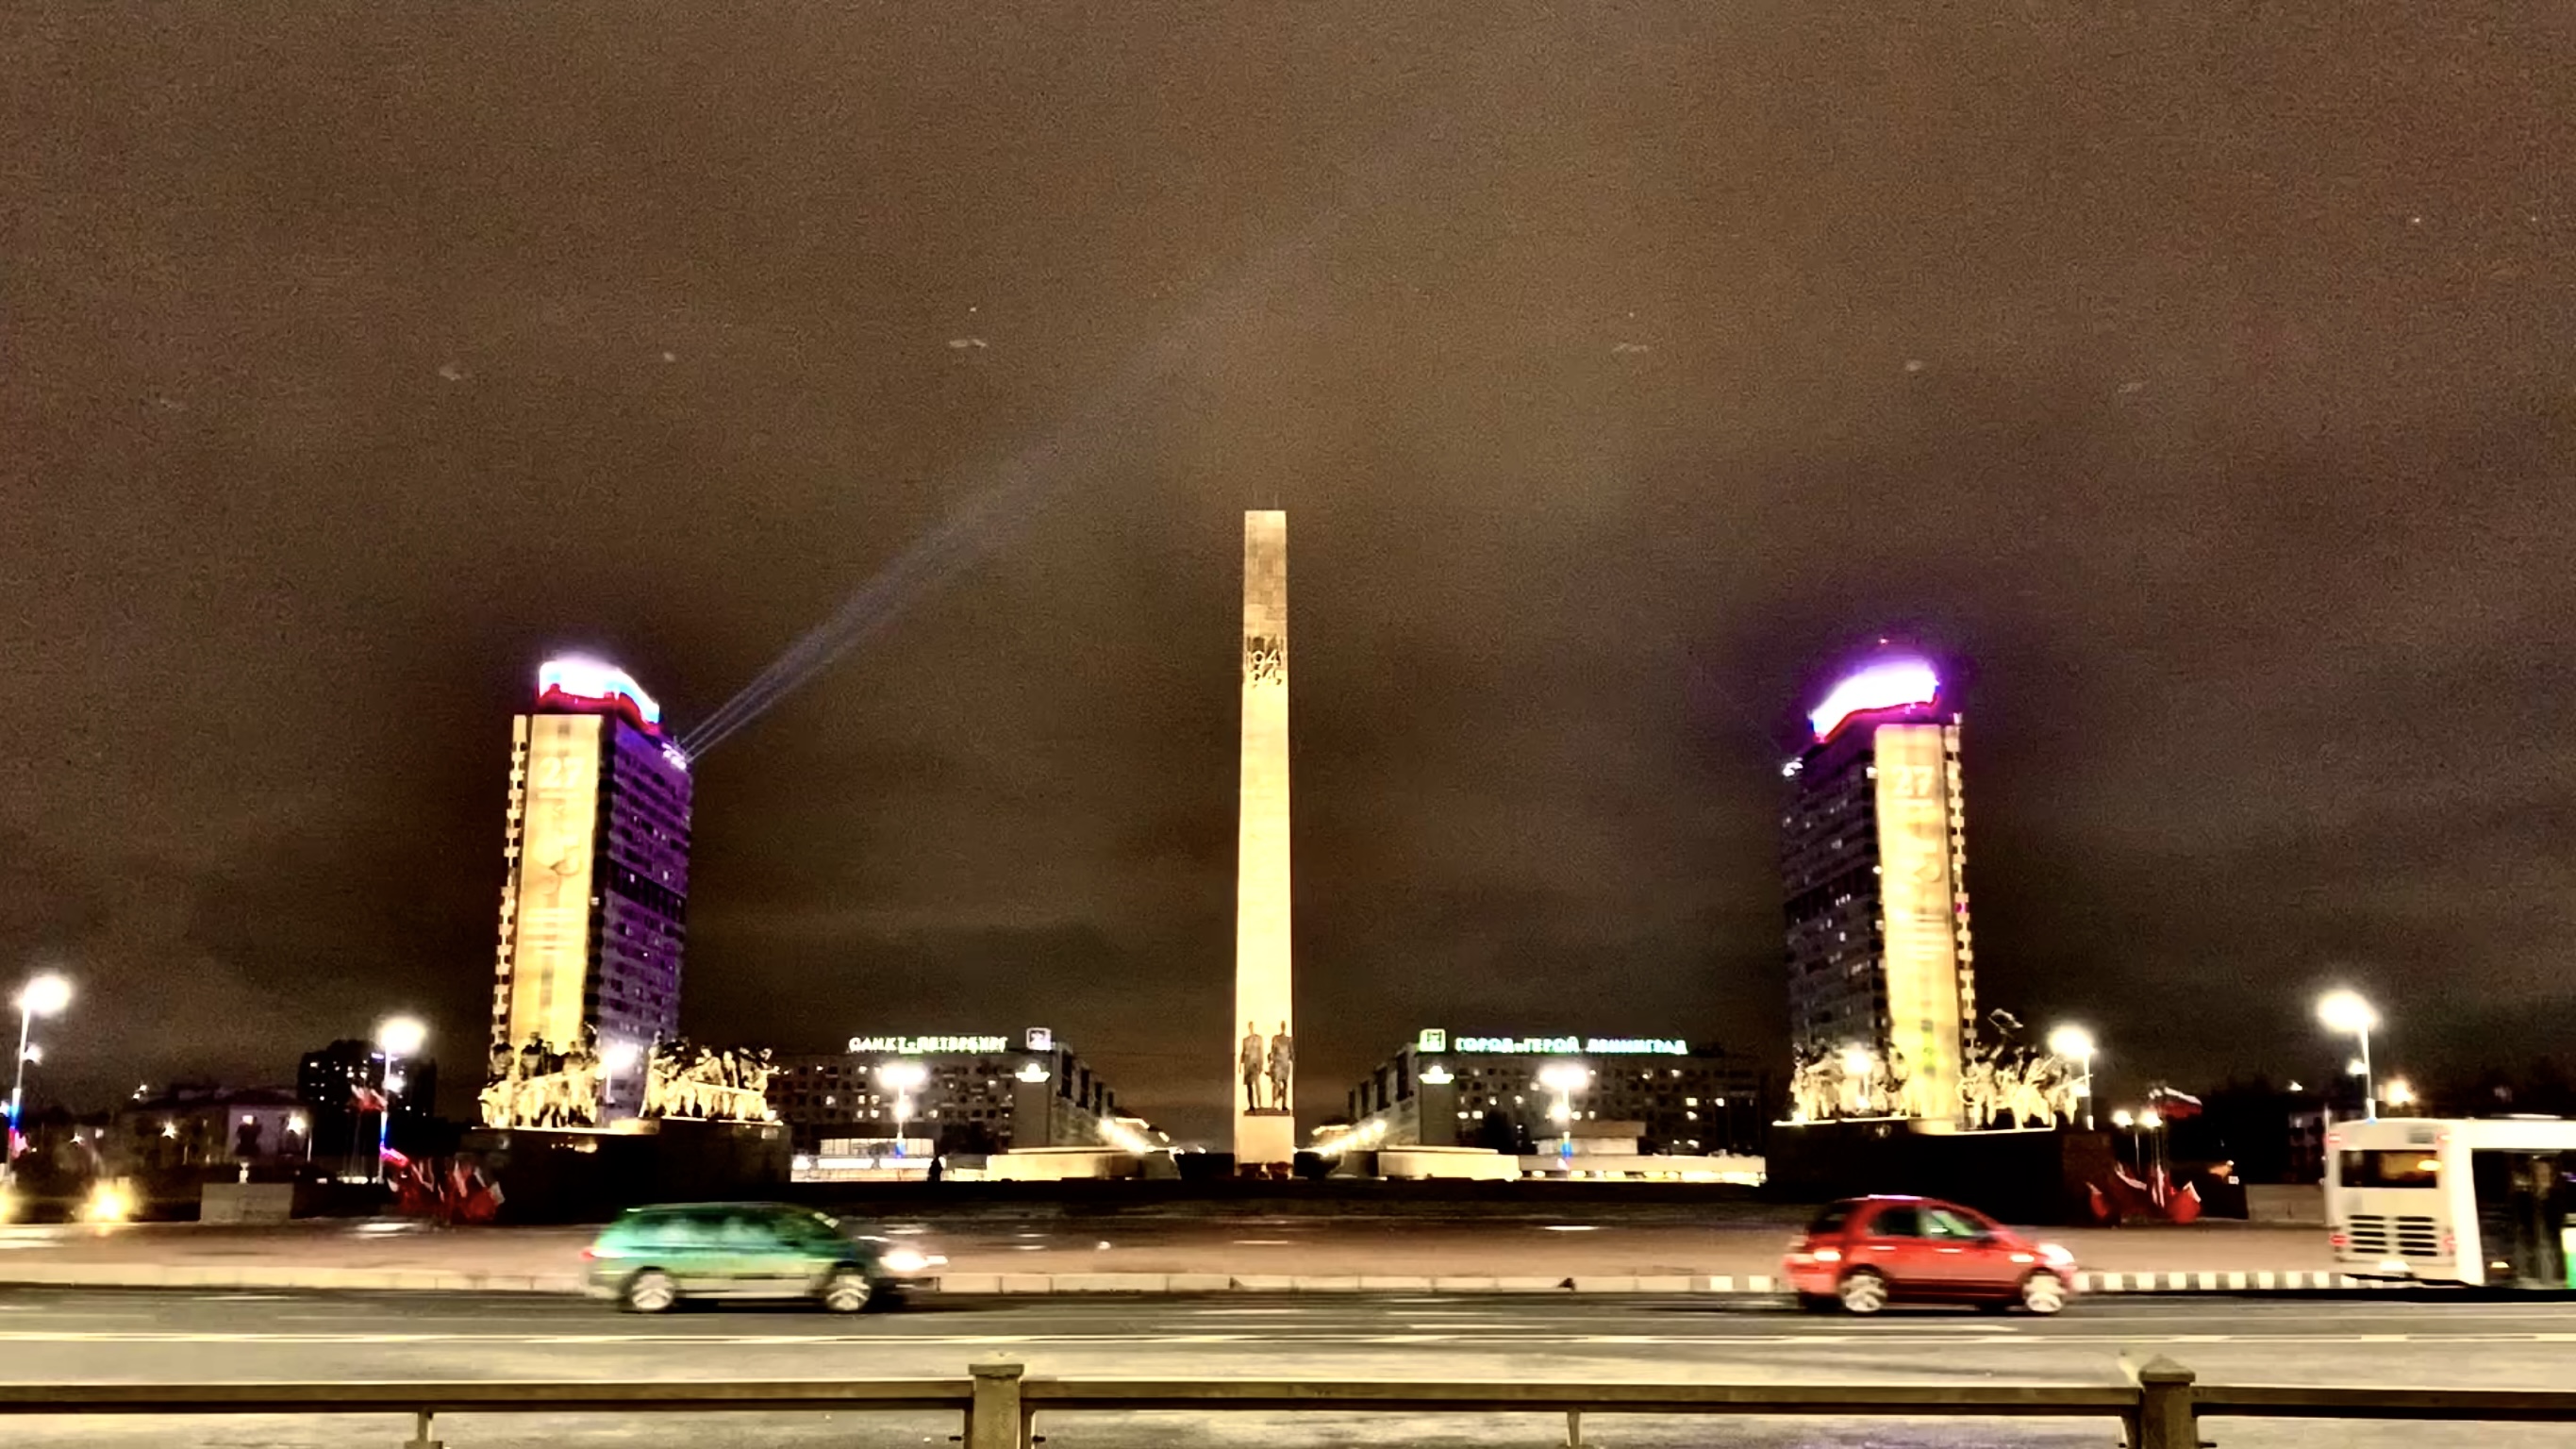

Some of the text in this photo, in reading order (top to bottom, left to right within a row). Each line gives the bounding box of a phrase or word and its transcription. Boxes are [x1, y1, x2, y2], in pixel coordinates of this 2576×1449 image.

[538, 757, 584, 789] 27
[1889, 765, 1935, 796] 27
[1587, 1040, 1687, 1054] ЛЕНИНГРАД
